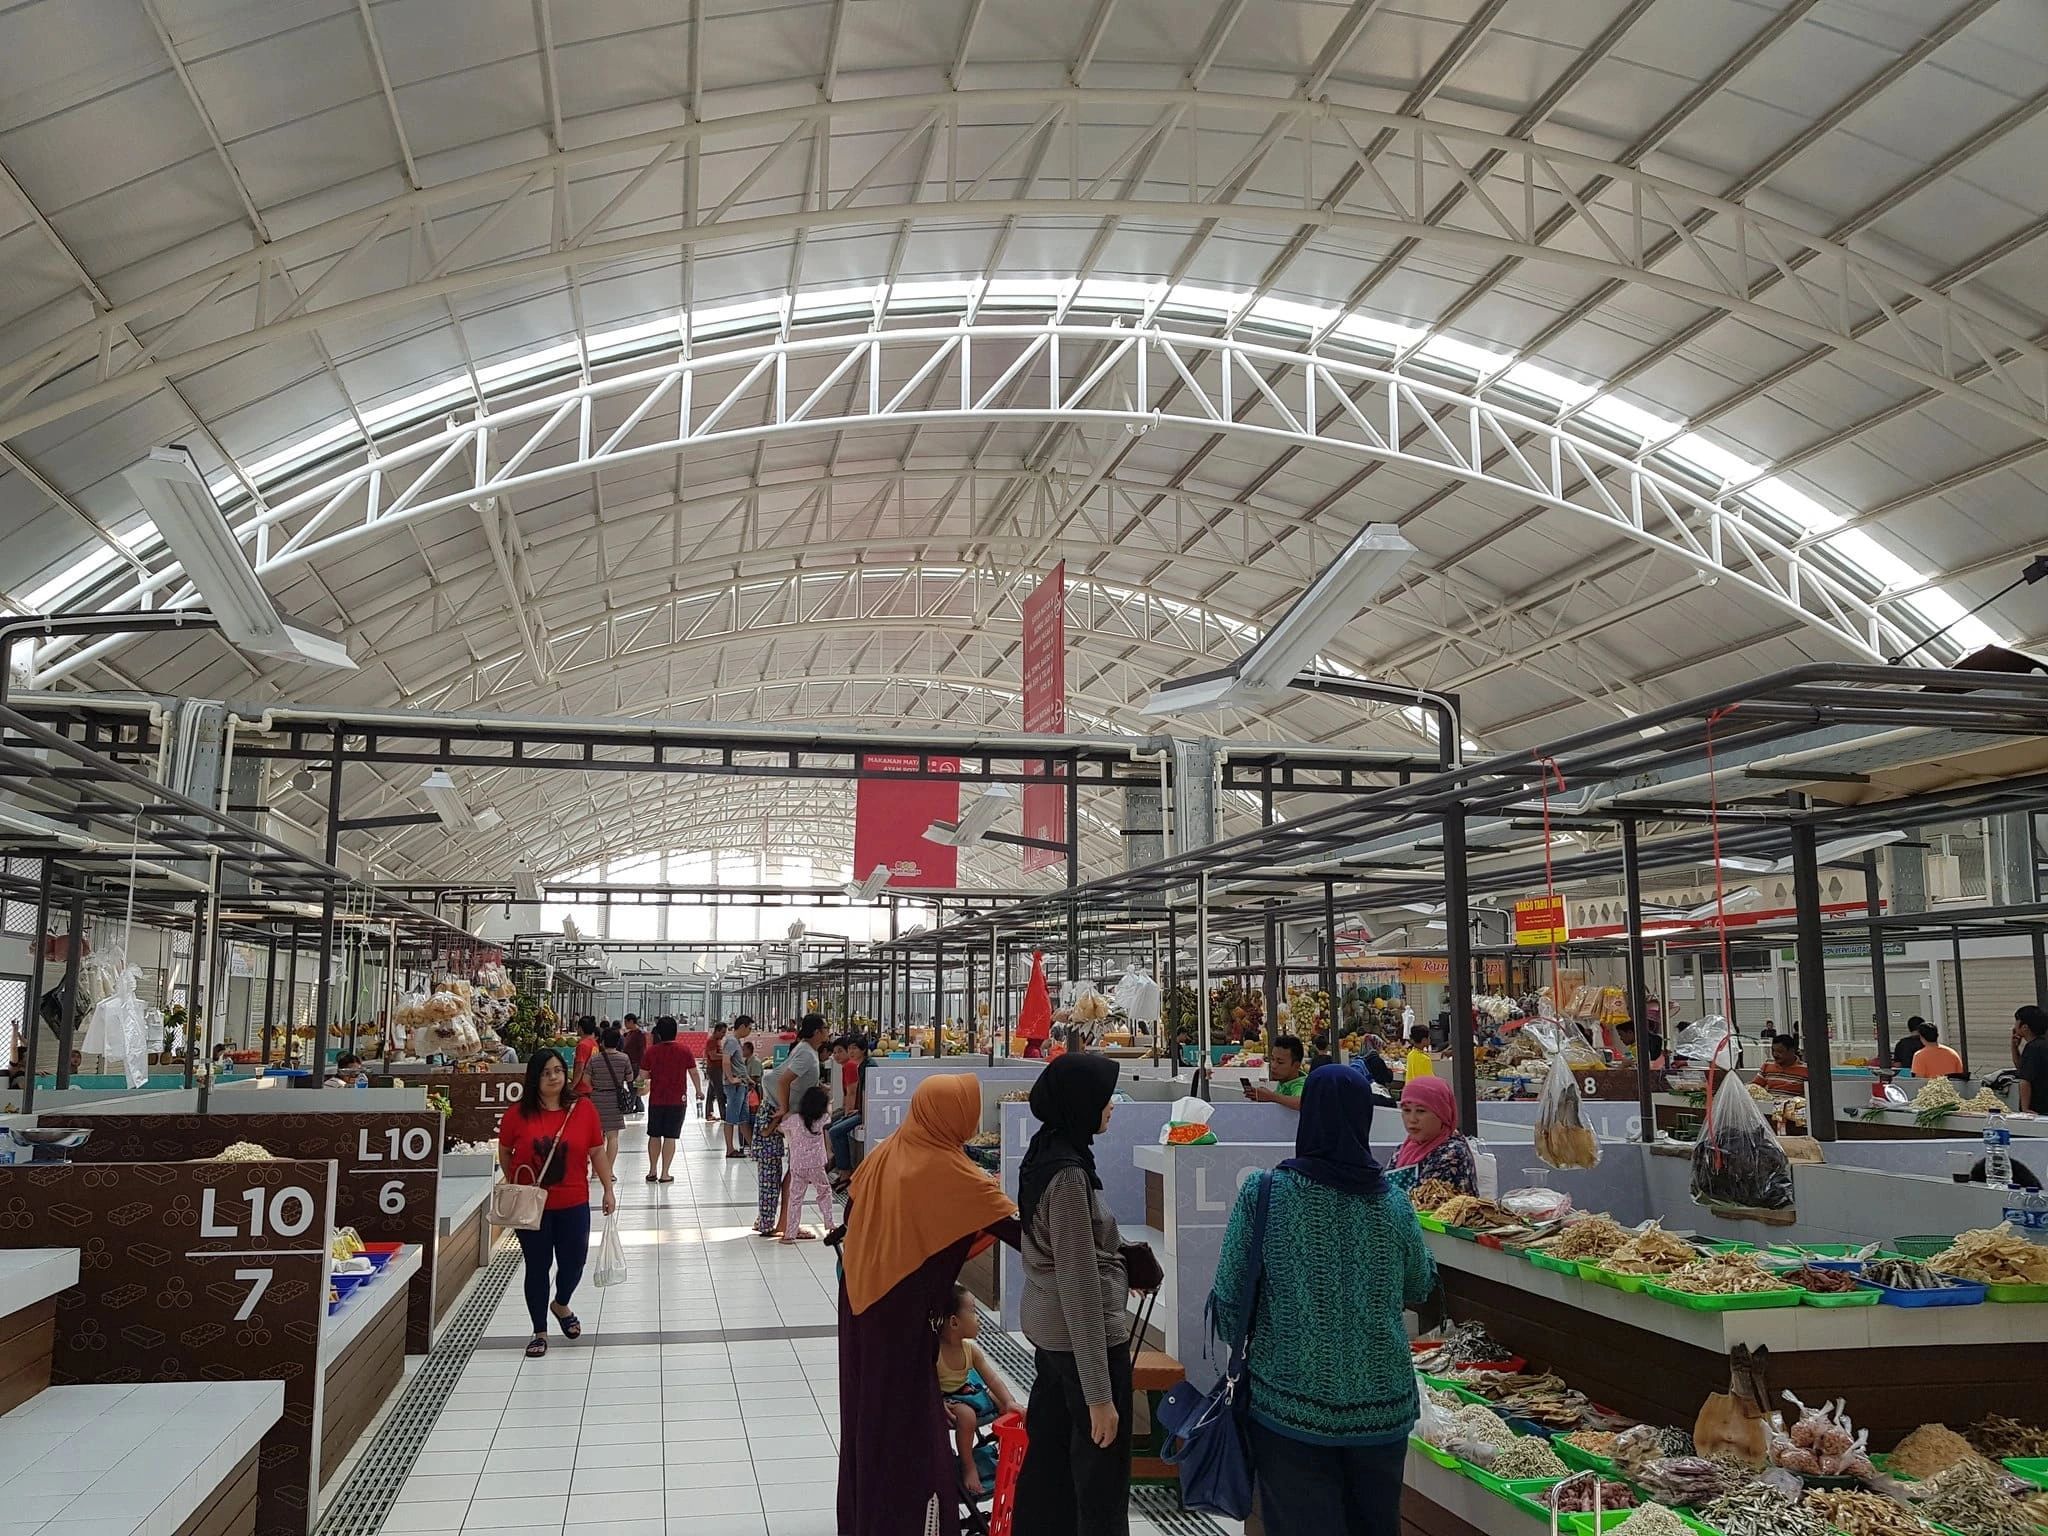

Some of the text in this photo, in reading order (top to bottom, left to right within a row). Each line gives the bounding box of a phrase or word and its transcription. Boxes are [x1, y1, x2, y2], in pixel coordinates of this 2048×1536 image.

[776, 1049, 790, 1060] L
[480, 1082, 524, 1102] L10
[1584, 1077, 1597, 1095] 8
[881, 1105, 902, 1125] 11
[358, 1127, 432, 1161] L10
[379, 1180, 406, 1215] 6
[200, 1186, 314, 1238] L10
[233, 1268, 273, 1321] 7
